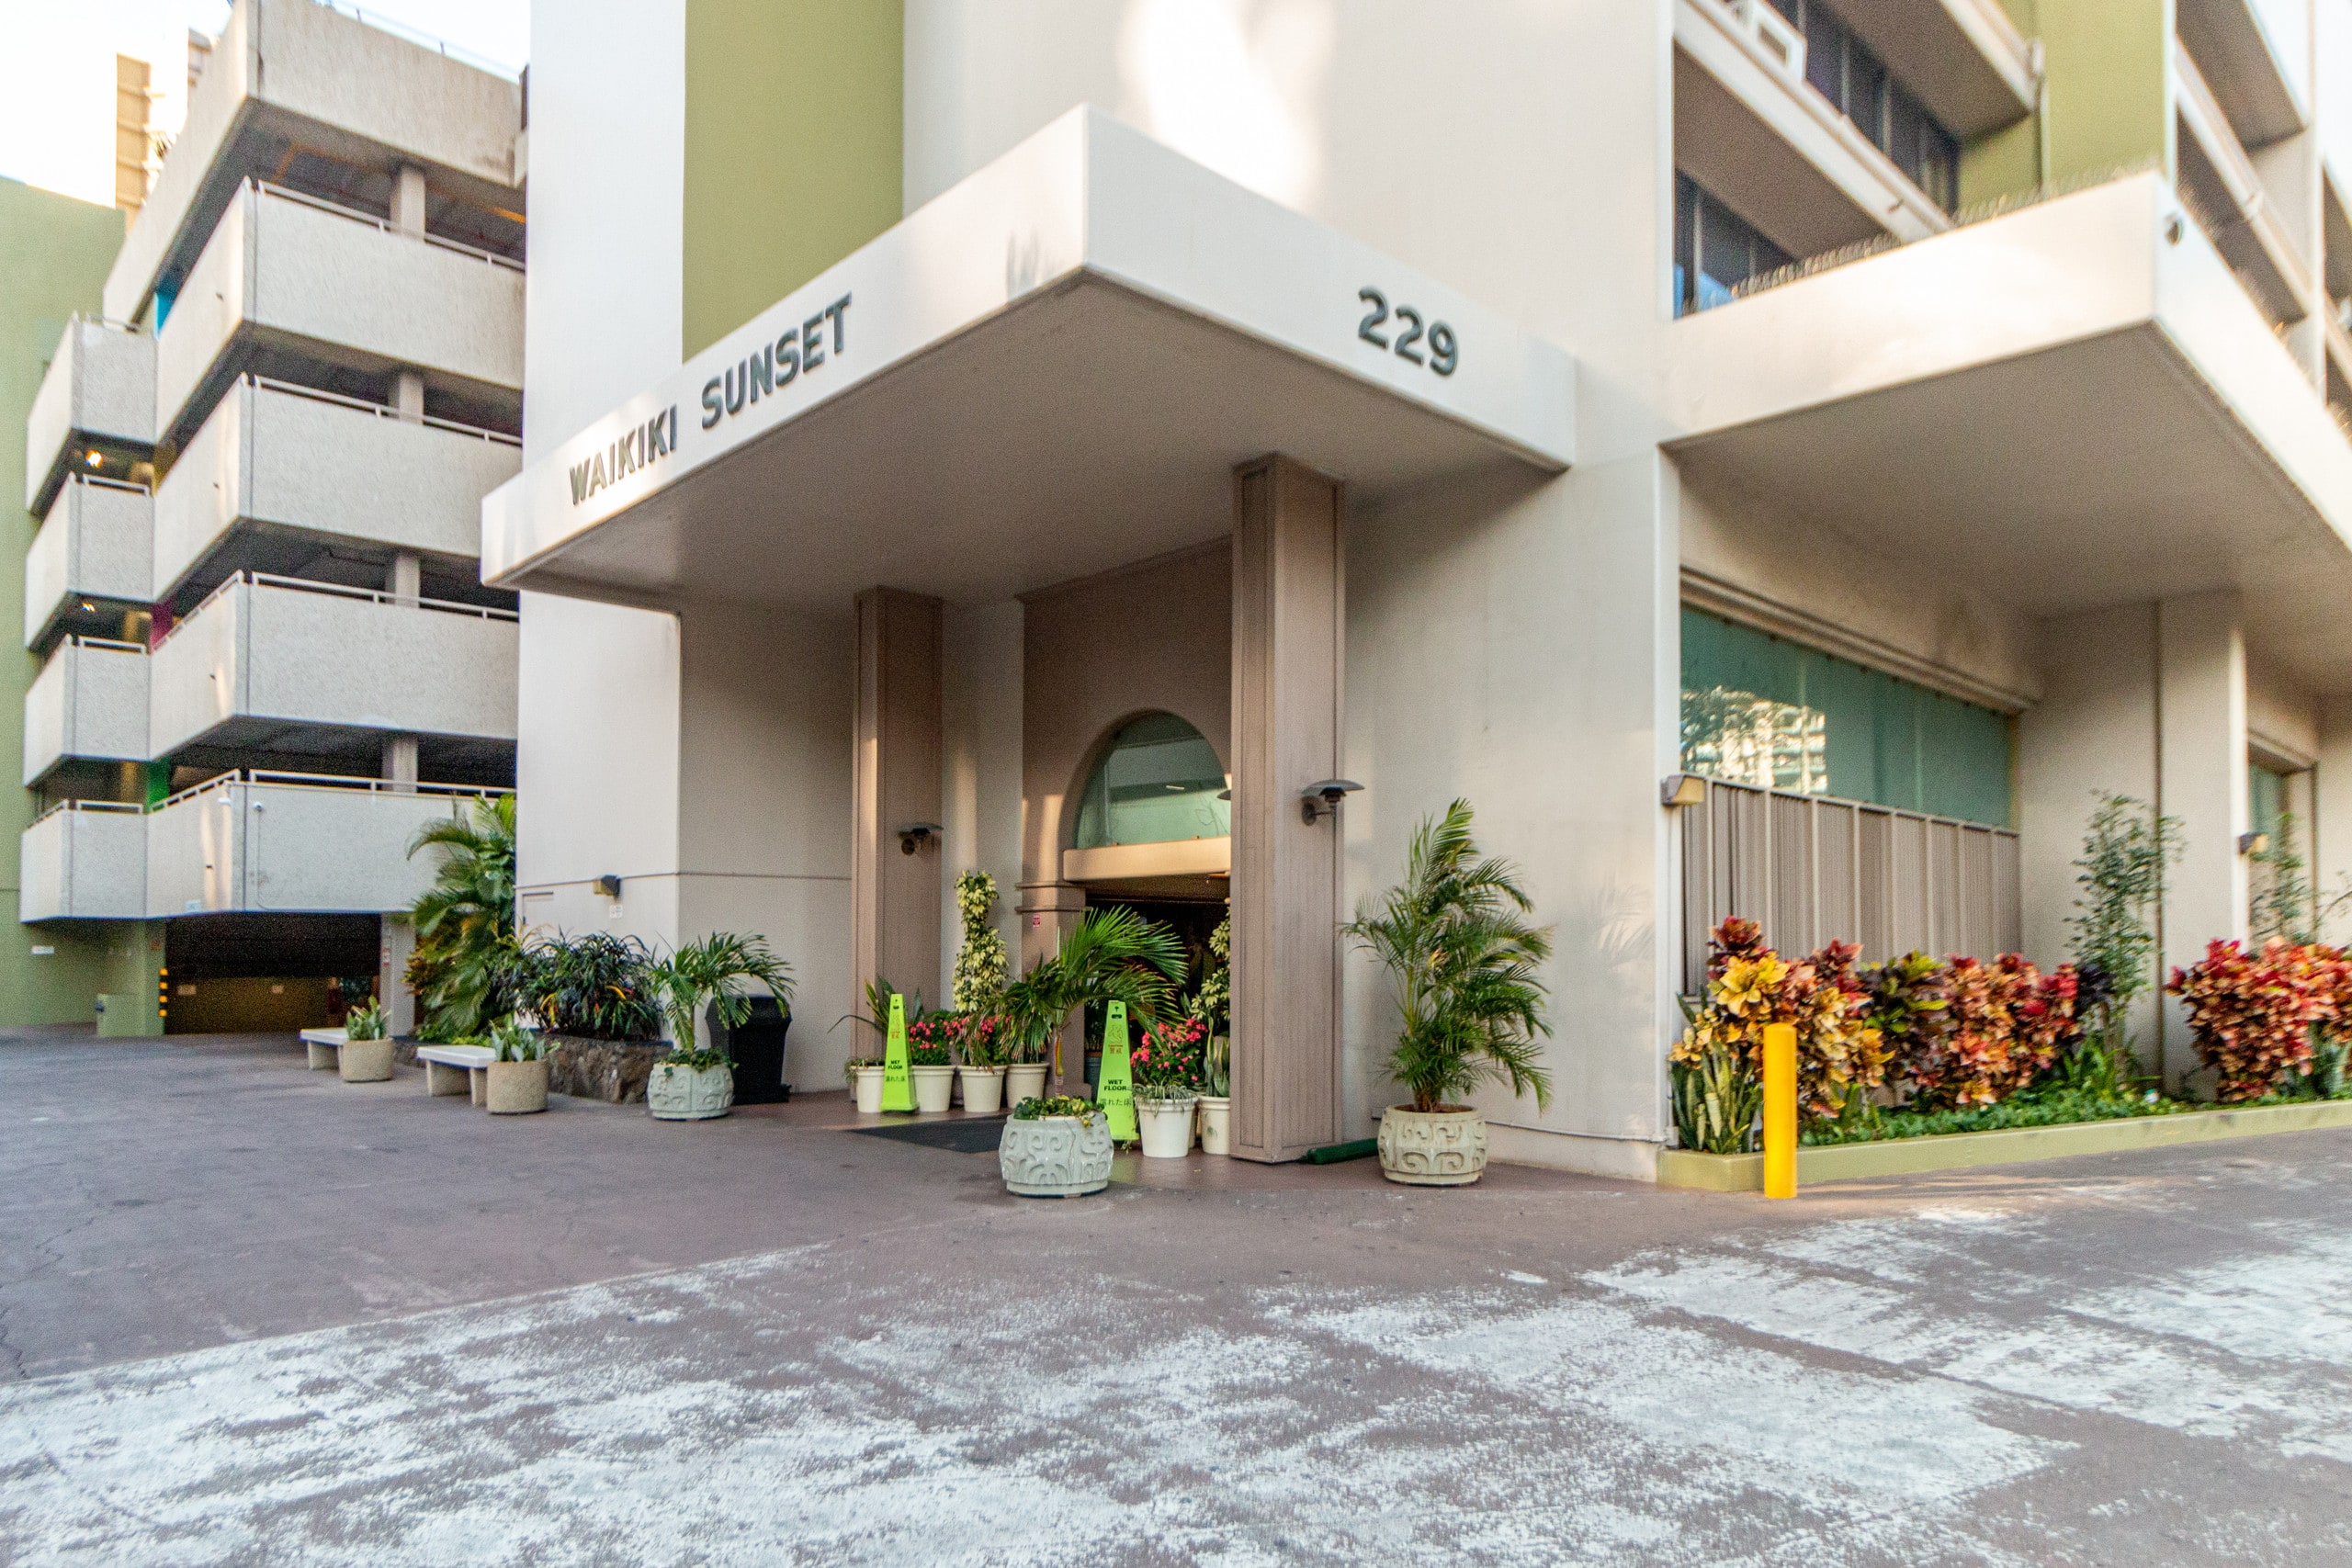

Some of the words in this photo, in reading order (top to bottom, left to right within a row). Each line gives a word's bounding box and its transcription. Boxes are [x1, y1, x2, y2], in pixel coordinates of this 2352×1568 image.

[569, 402, 678, 505] WAIKIKI
[701, 290, 853, 430] SUNSET
[1358, 286, 1459, 378] 229
